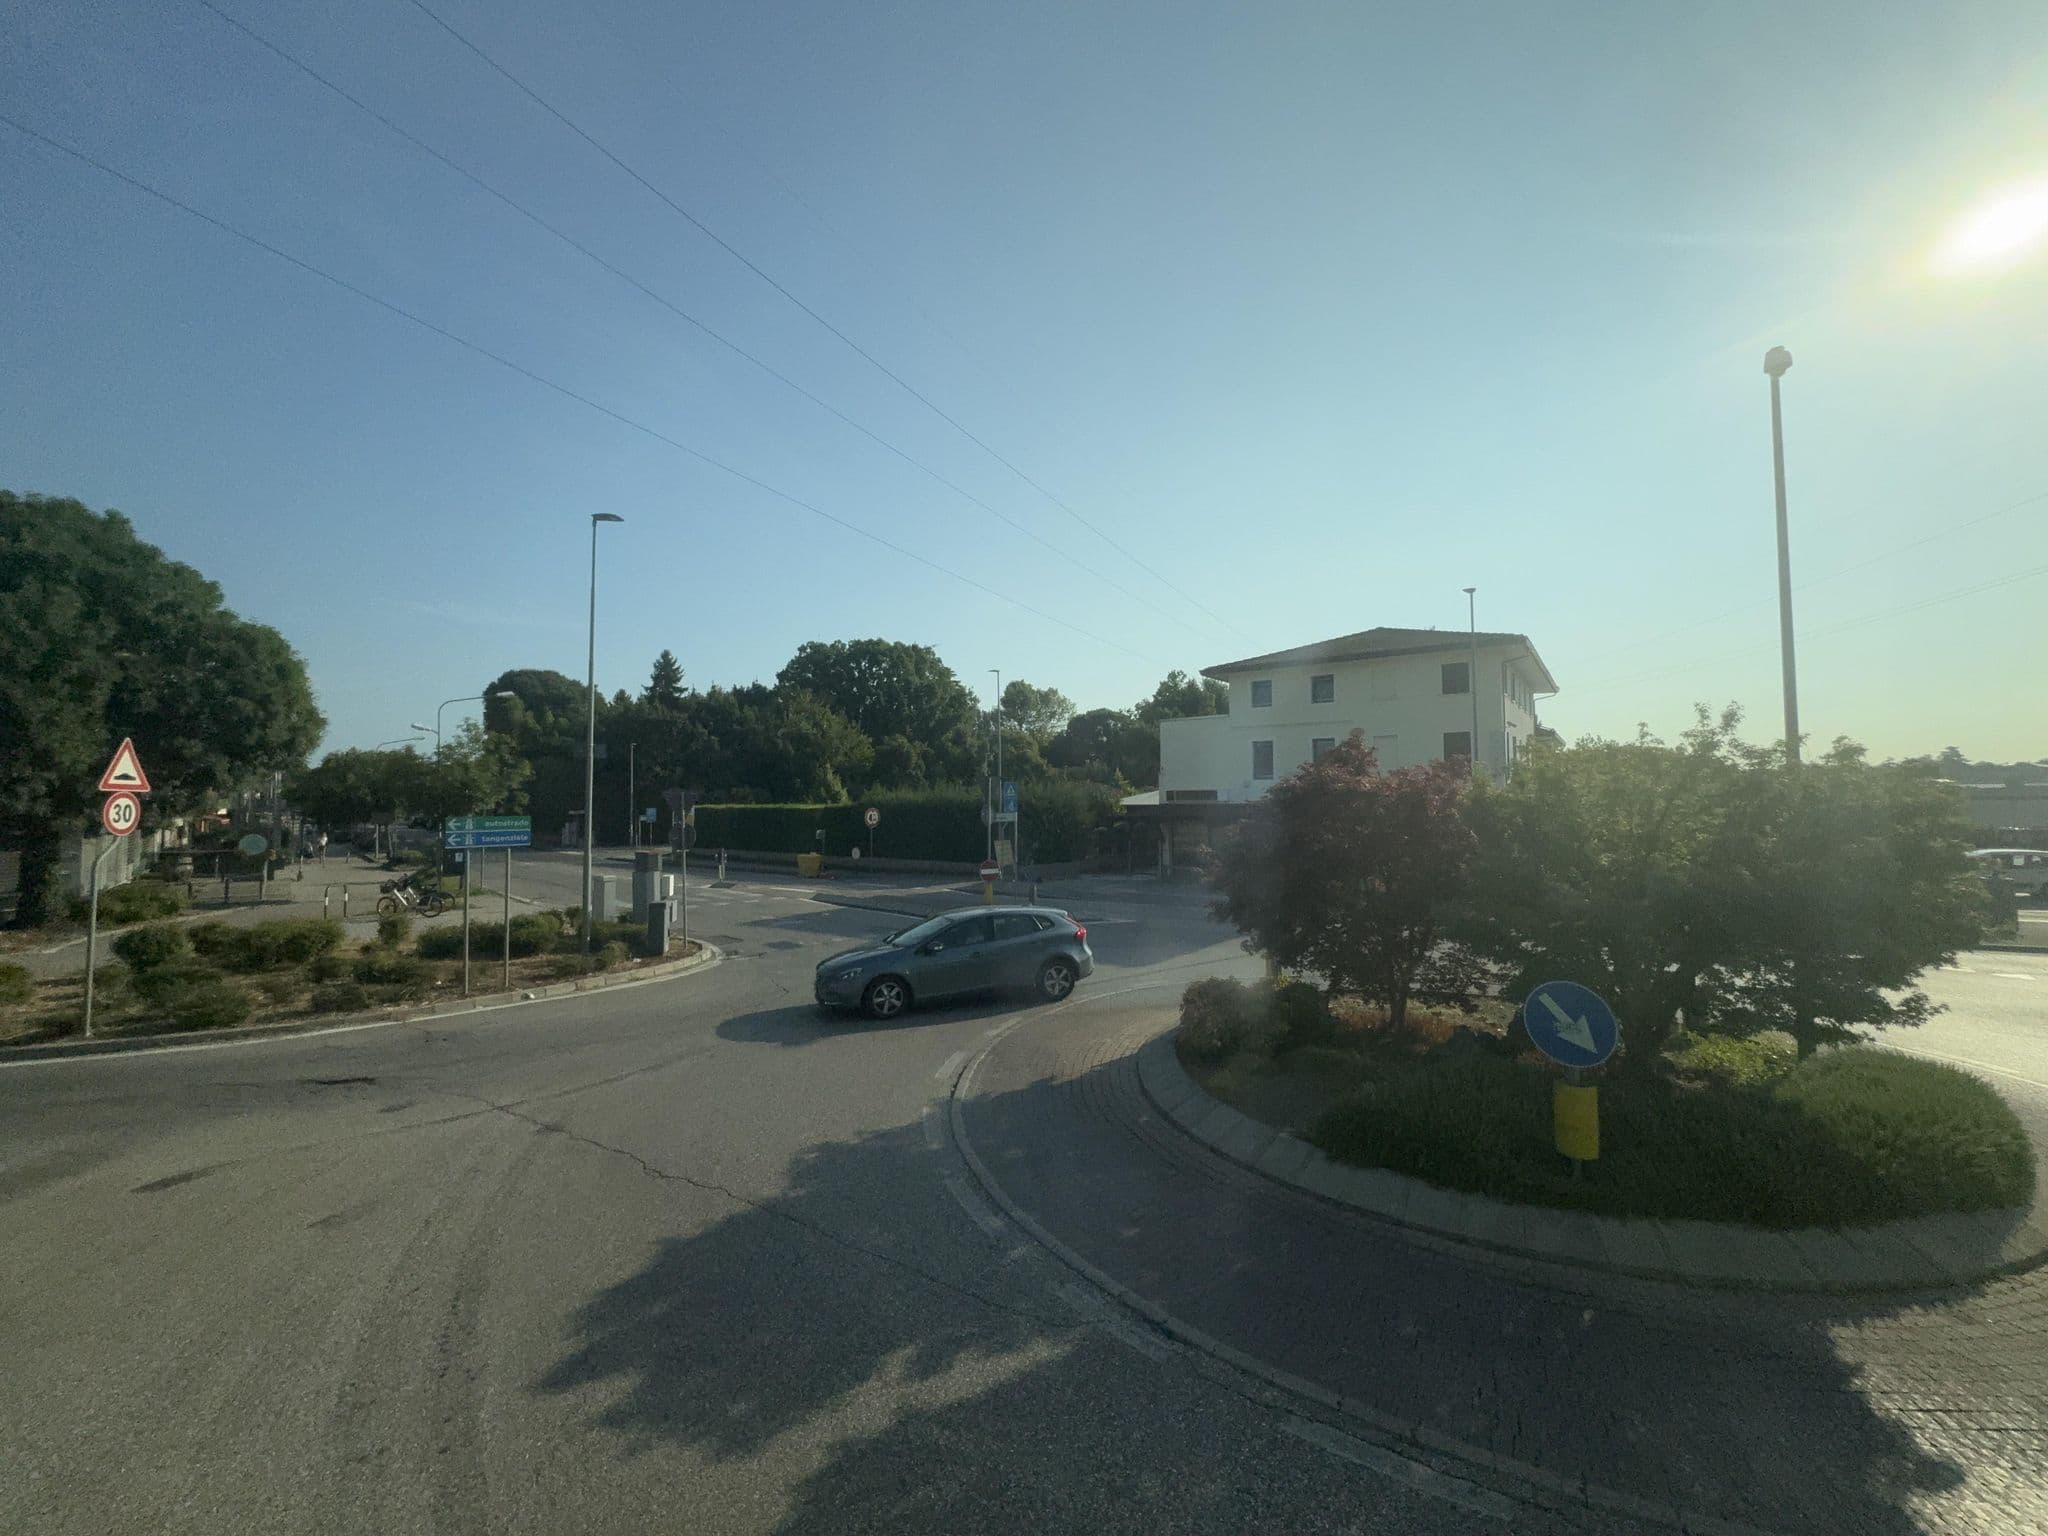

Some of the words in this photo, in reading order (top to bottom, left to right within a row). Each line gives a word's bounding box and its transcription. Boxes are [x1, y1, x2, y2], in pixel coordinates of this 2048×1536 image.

[112, 803, 132, 823] 30
[485, 819, 529, 827] autostrada
[481, 834, 529, 842] tangenziale
